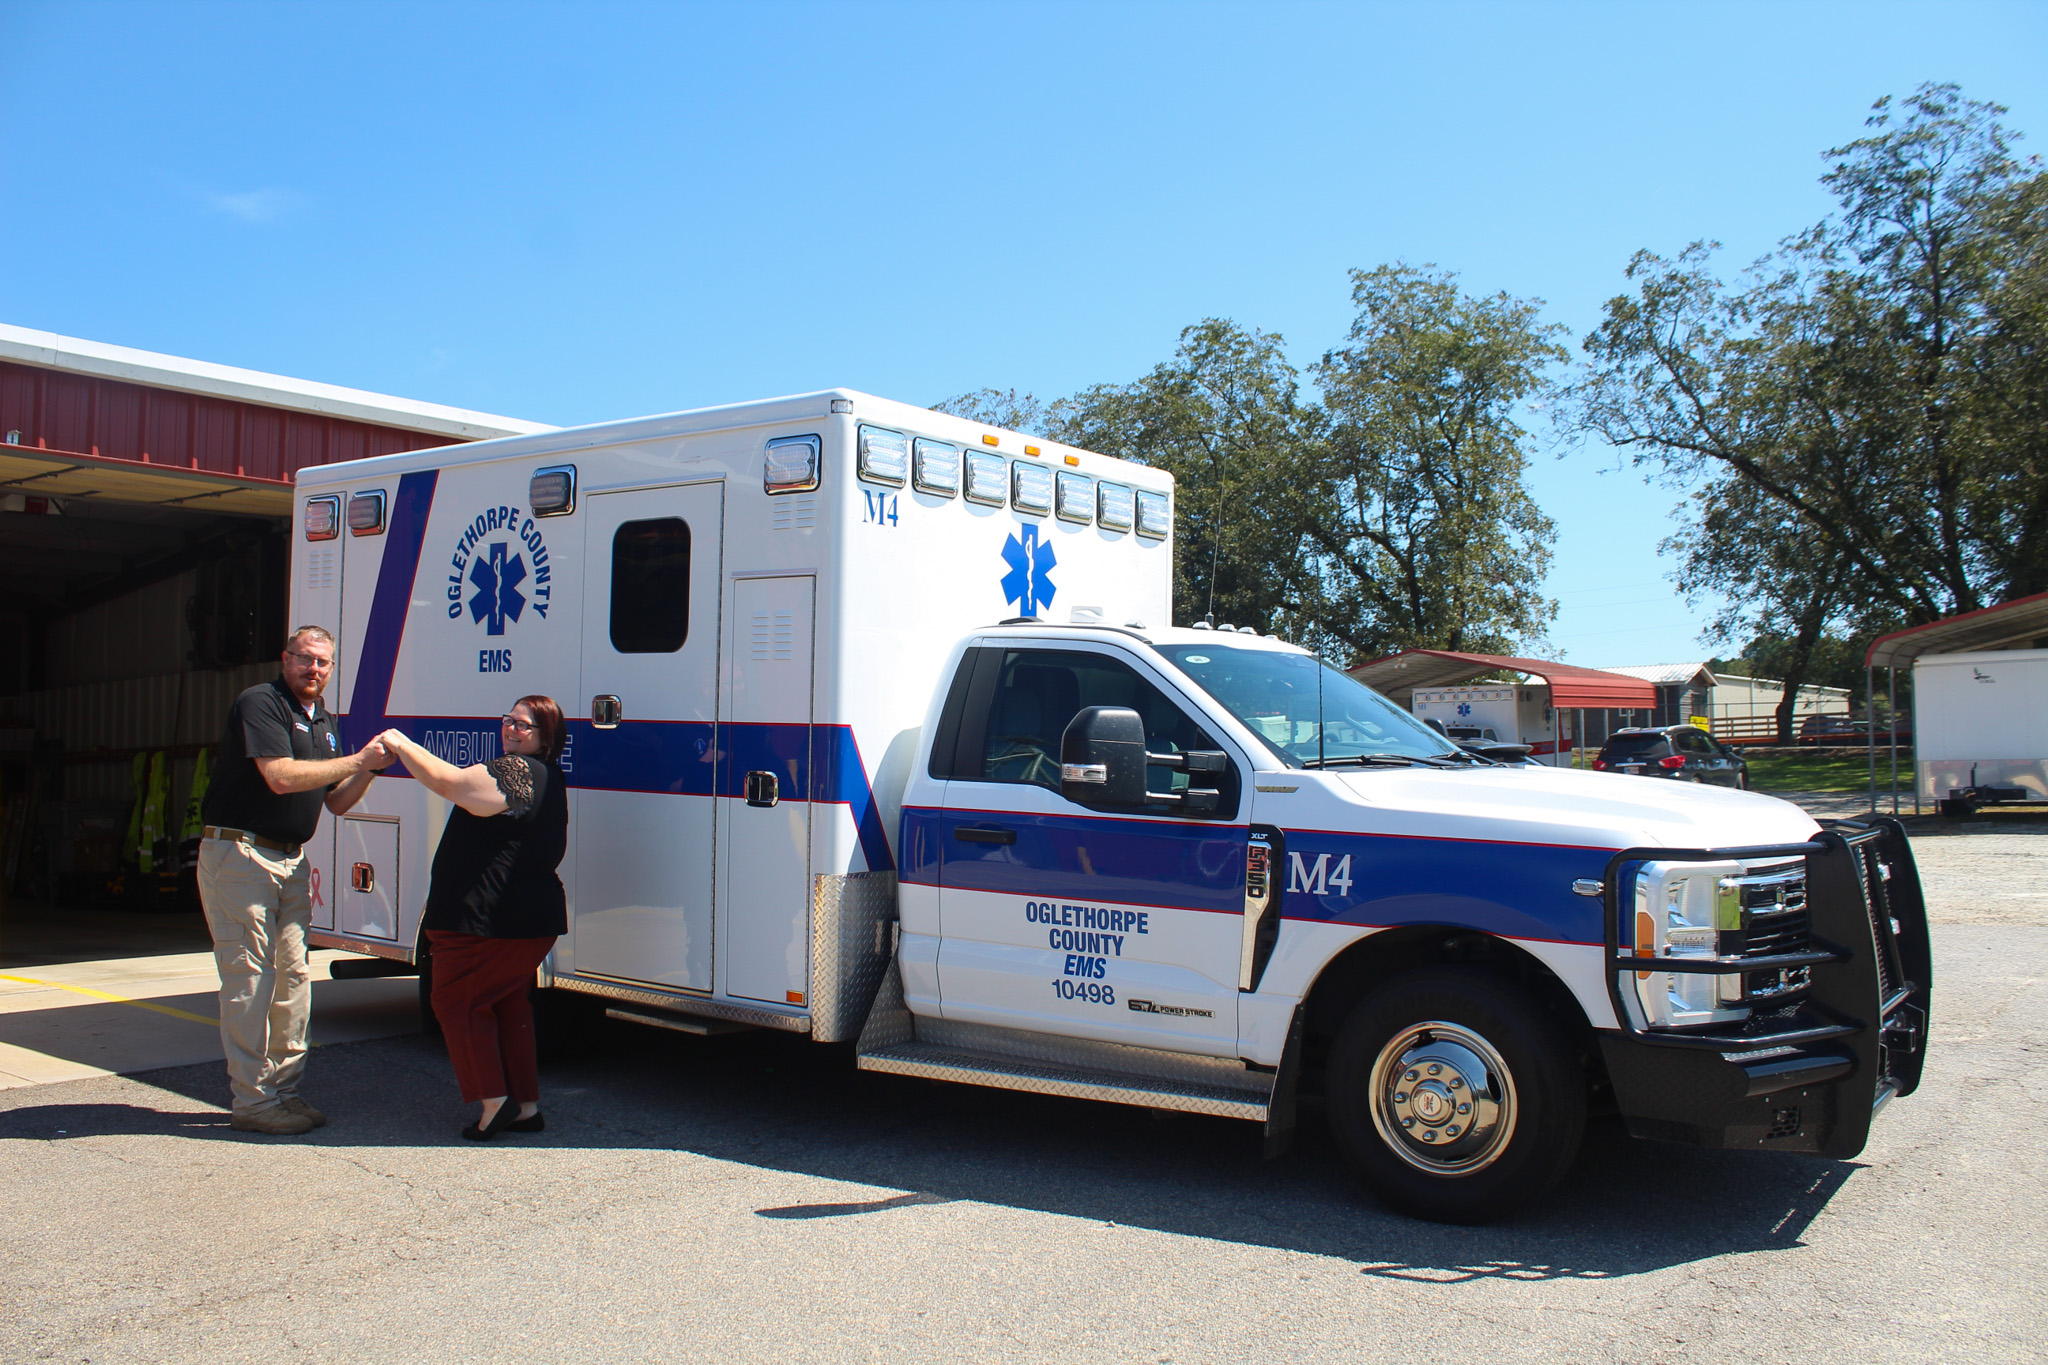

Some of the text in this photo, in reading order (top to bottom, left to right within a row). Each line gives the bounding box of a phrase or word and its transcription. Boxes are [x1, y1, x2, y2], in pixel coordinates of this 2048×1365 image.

[862, 489, 899, 527] M4
[447, 505, 552, 619] OGLETHORPE COUNTY
[479, 649, 512, 672] EMS
[1286, 851, 1353, 896] M4
[1026, 901, 1149, 934] OGLETHORPE
[1049, 928, 1124, 956] COUNTY
[1063, 953, 1107, 979] EMS
[1052, 979, 1115, 1005] 10498
[1160, 1006, 1184, 1015] POWER
[1185, 1009, 1213, 1018] STROKE
